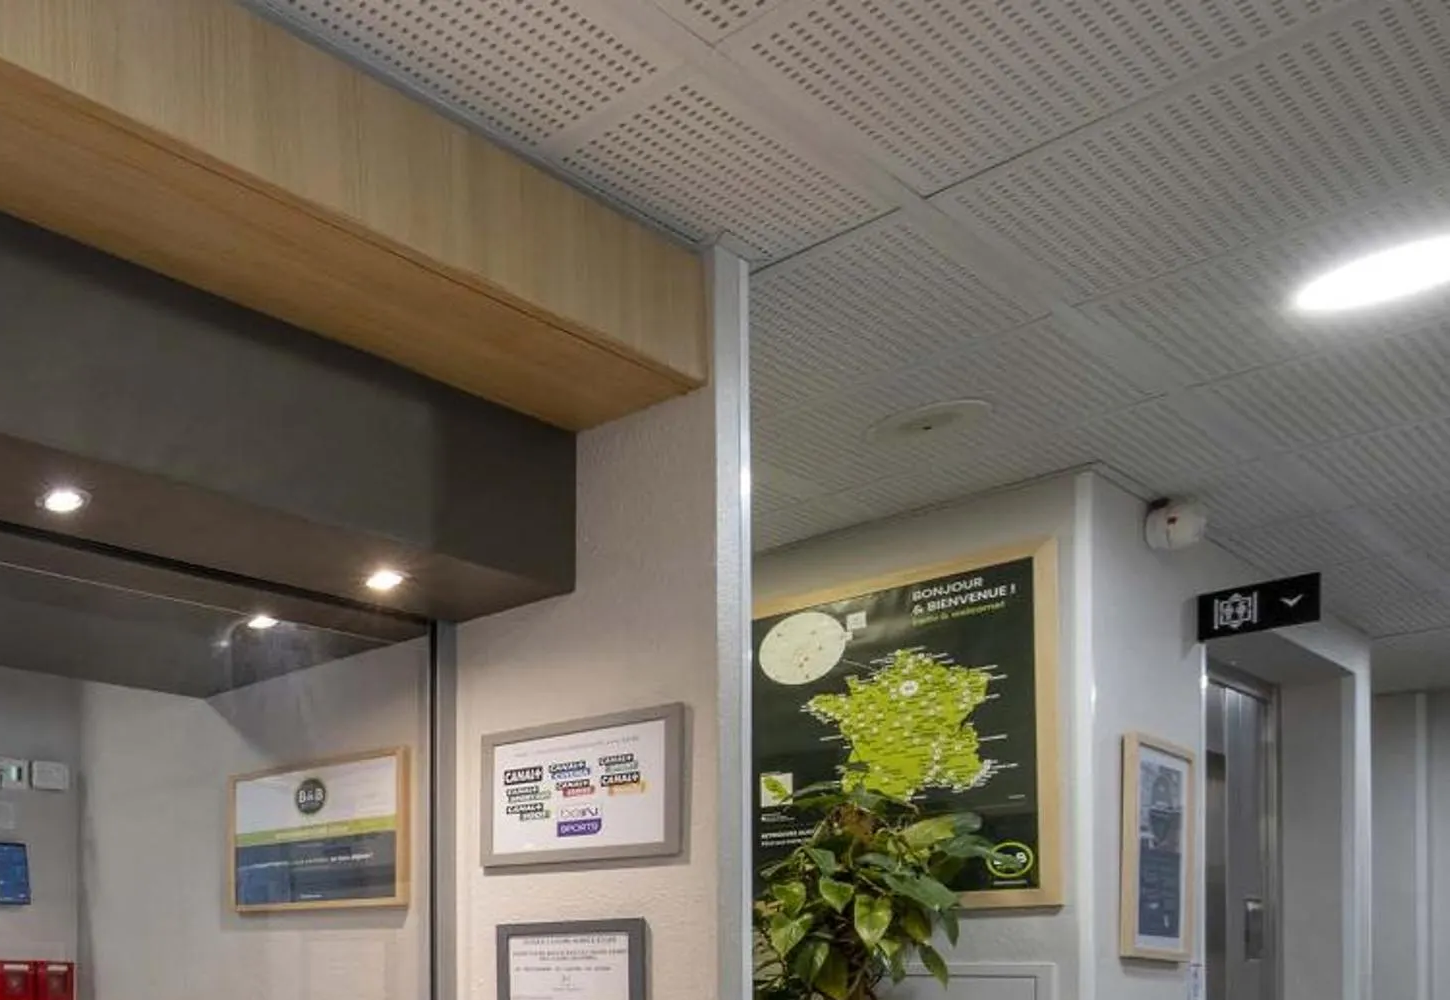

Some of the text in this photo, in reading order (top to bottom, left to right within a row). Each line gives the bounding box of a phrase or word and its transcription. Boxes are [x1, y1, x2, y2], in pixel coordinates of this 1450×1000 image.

[912, 577, 983, 601] BONJOUR
[927, 586, 1007, 612] BIENVENUE
[505, 768, 542, 783] CANAL+
[602, 772, 639, 786] CANAL+
